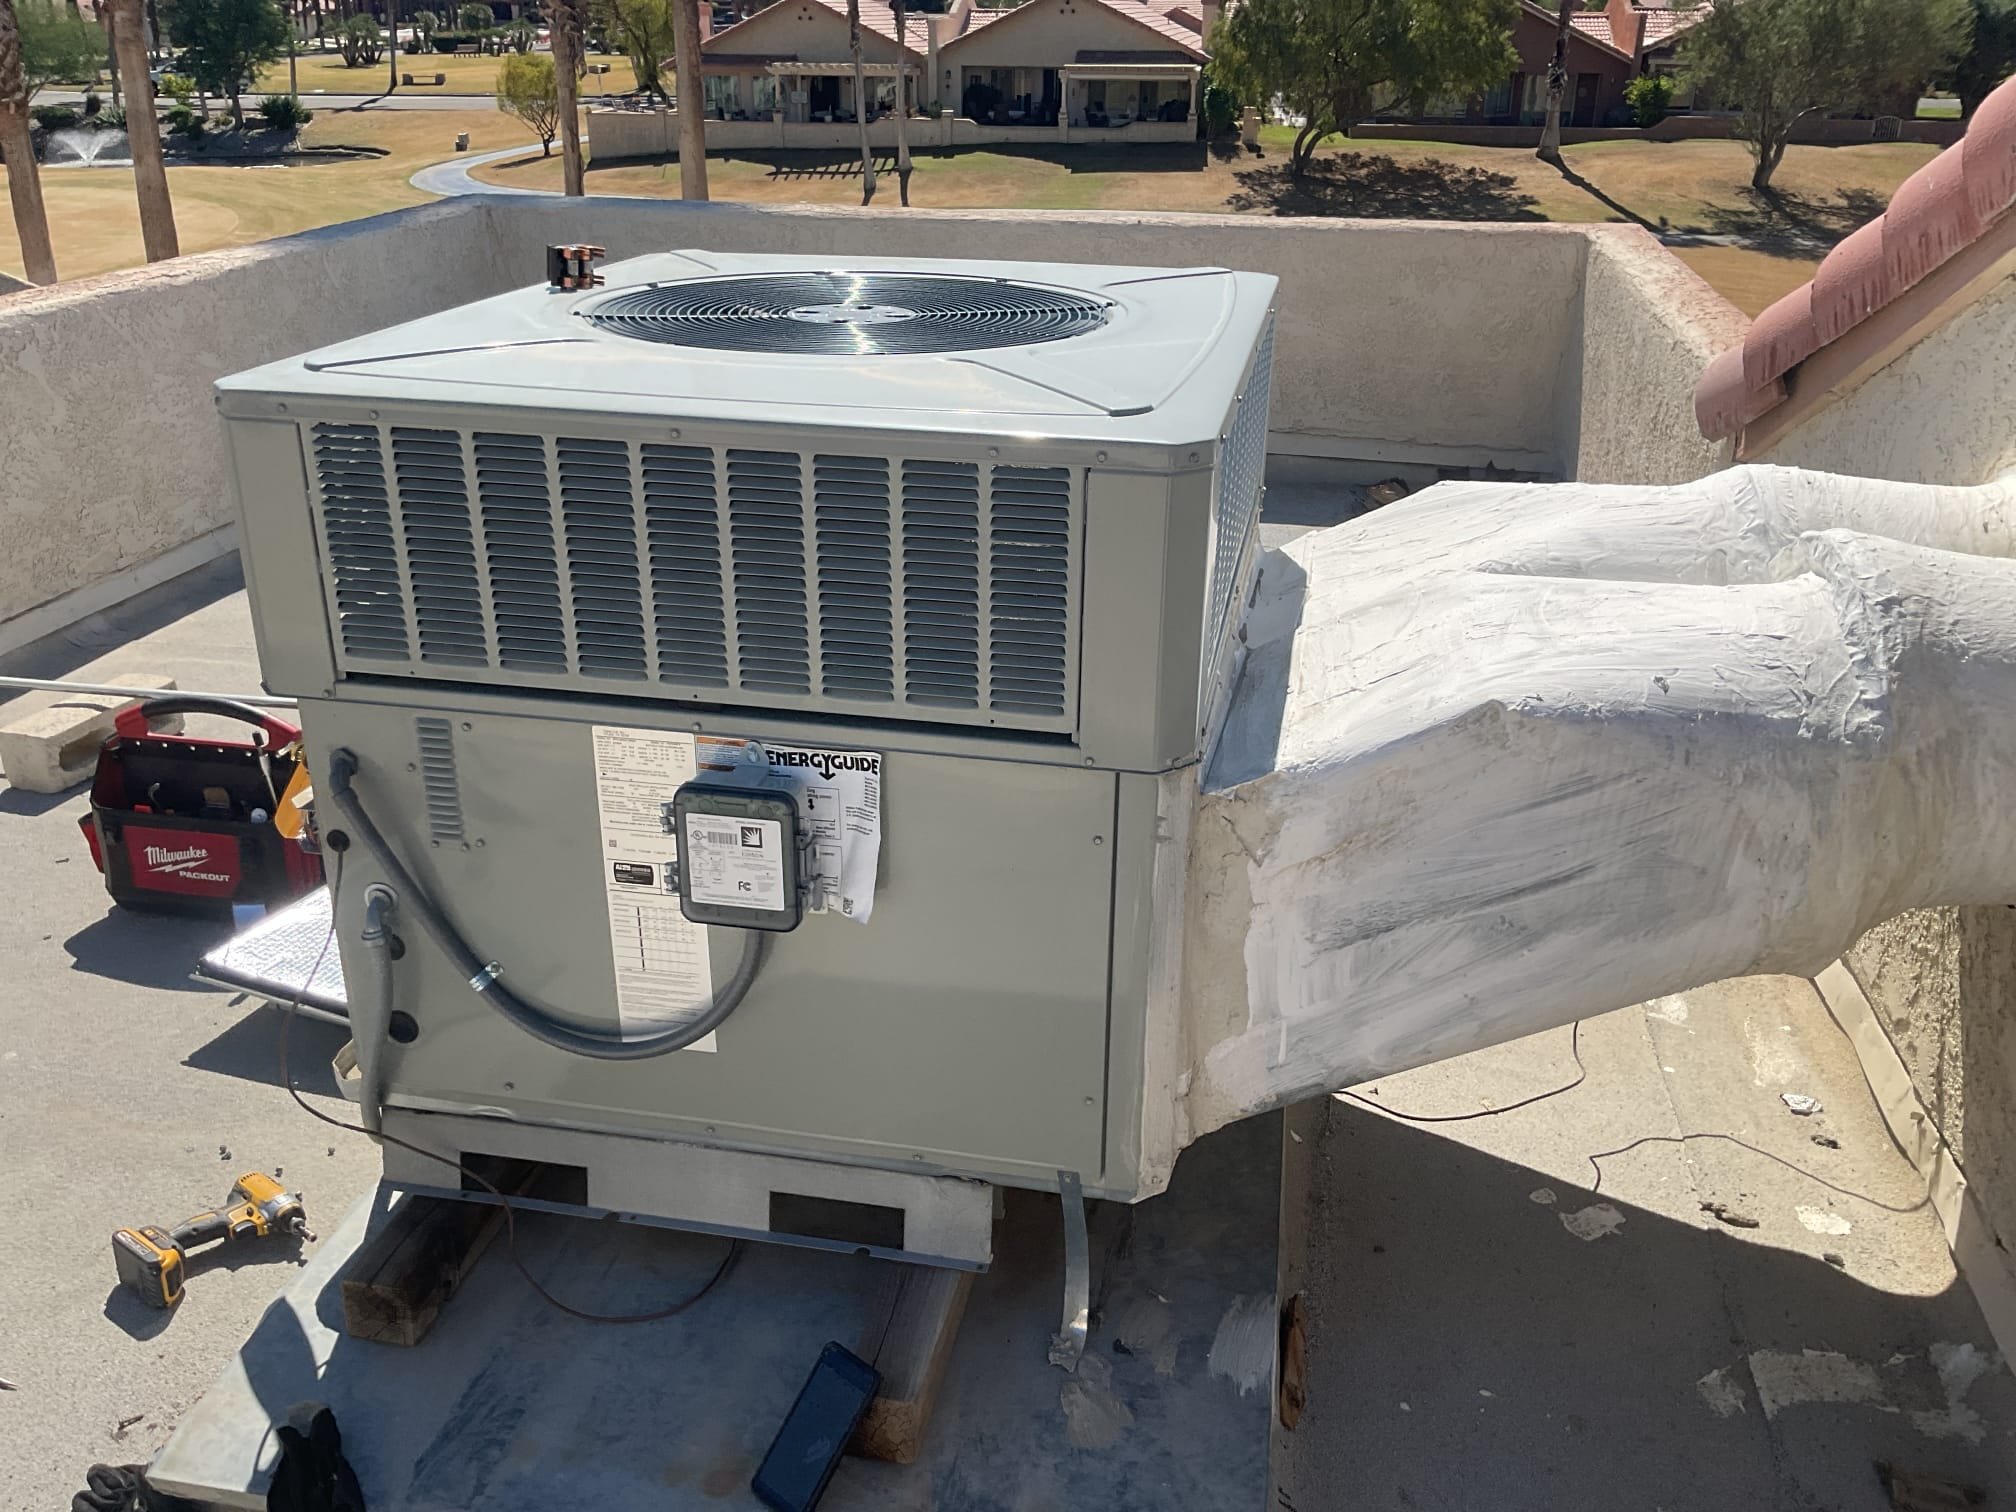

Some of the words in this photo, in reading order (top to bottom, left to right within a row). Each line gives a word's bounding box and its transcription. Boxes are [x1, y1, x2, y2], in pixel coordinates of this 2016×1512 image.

[766, 749, 879, 776] ENERGYGUIDE
[144, 846, 208, 865] Milwaukee
[179, 870, 230, 882] PACKOUT
